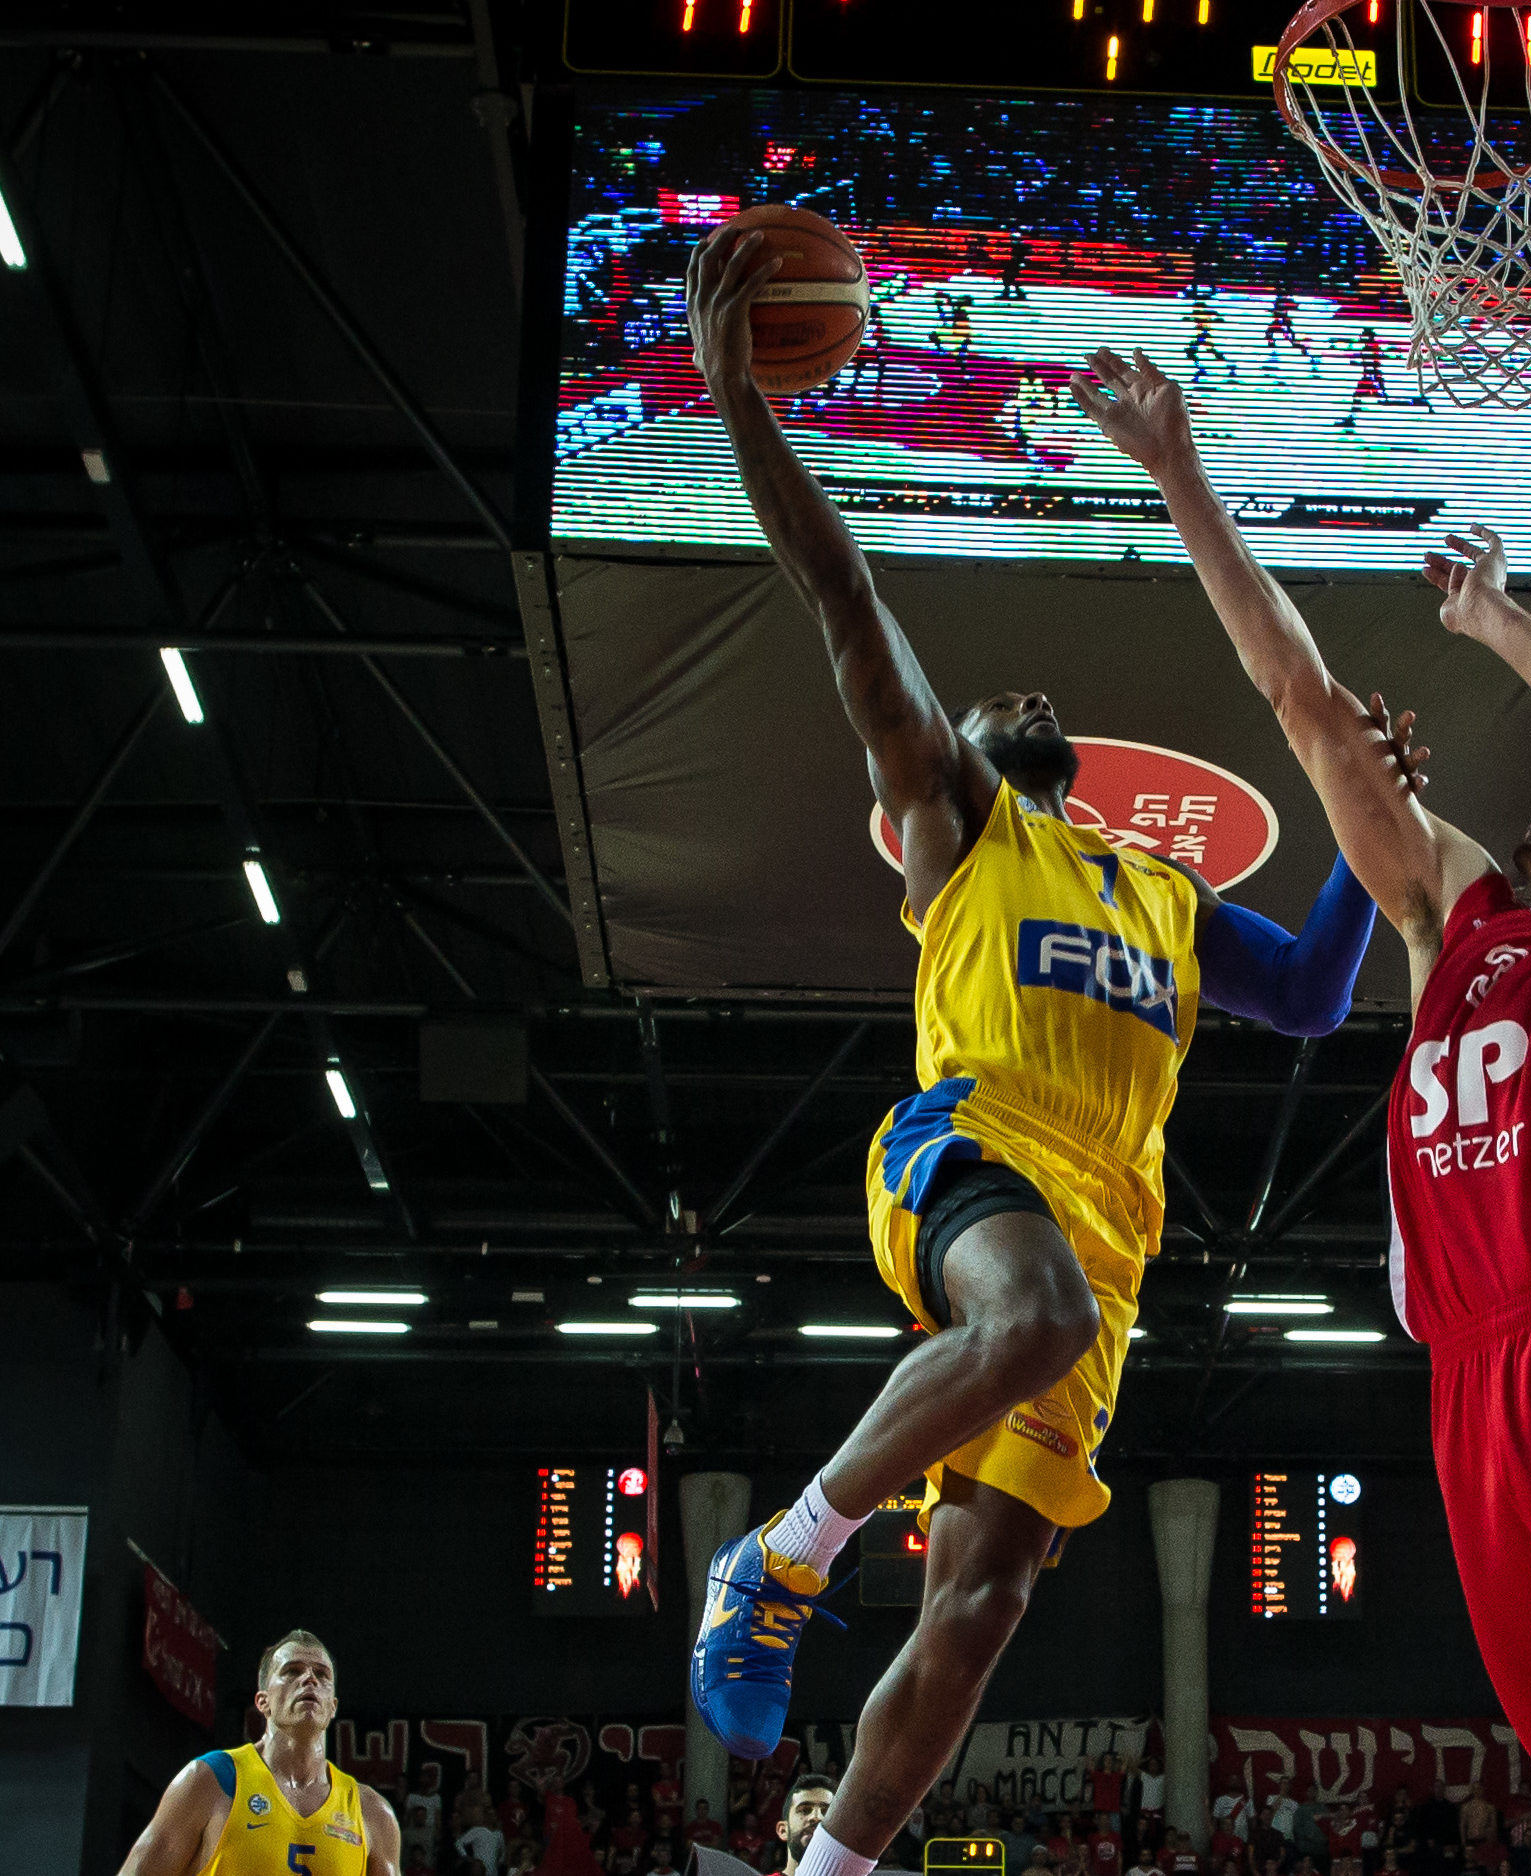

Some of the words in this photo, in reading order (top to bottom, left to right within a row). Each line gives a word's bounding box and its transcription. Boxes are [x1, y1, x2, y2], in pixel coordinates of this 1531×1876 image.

[1410, 1019, 1530, 1139] SP
[1416, 1121, 1526, 1178] netzer
[1006, 1721, 1121, 1758] ANTI
[287, 1842, 316, 1876] 5
